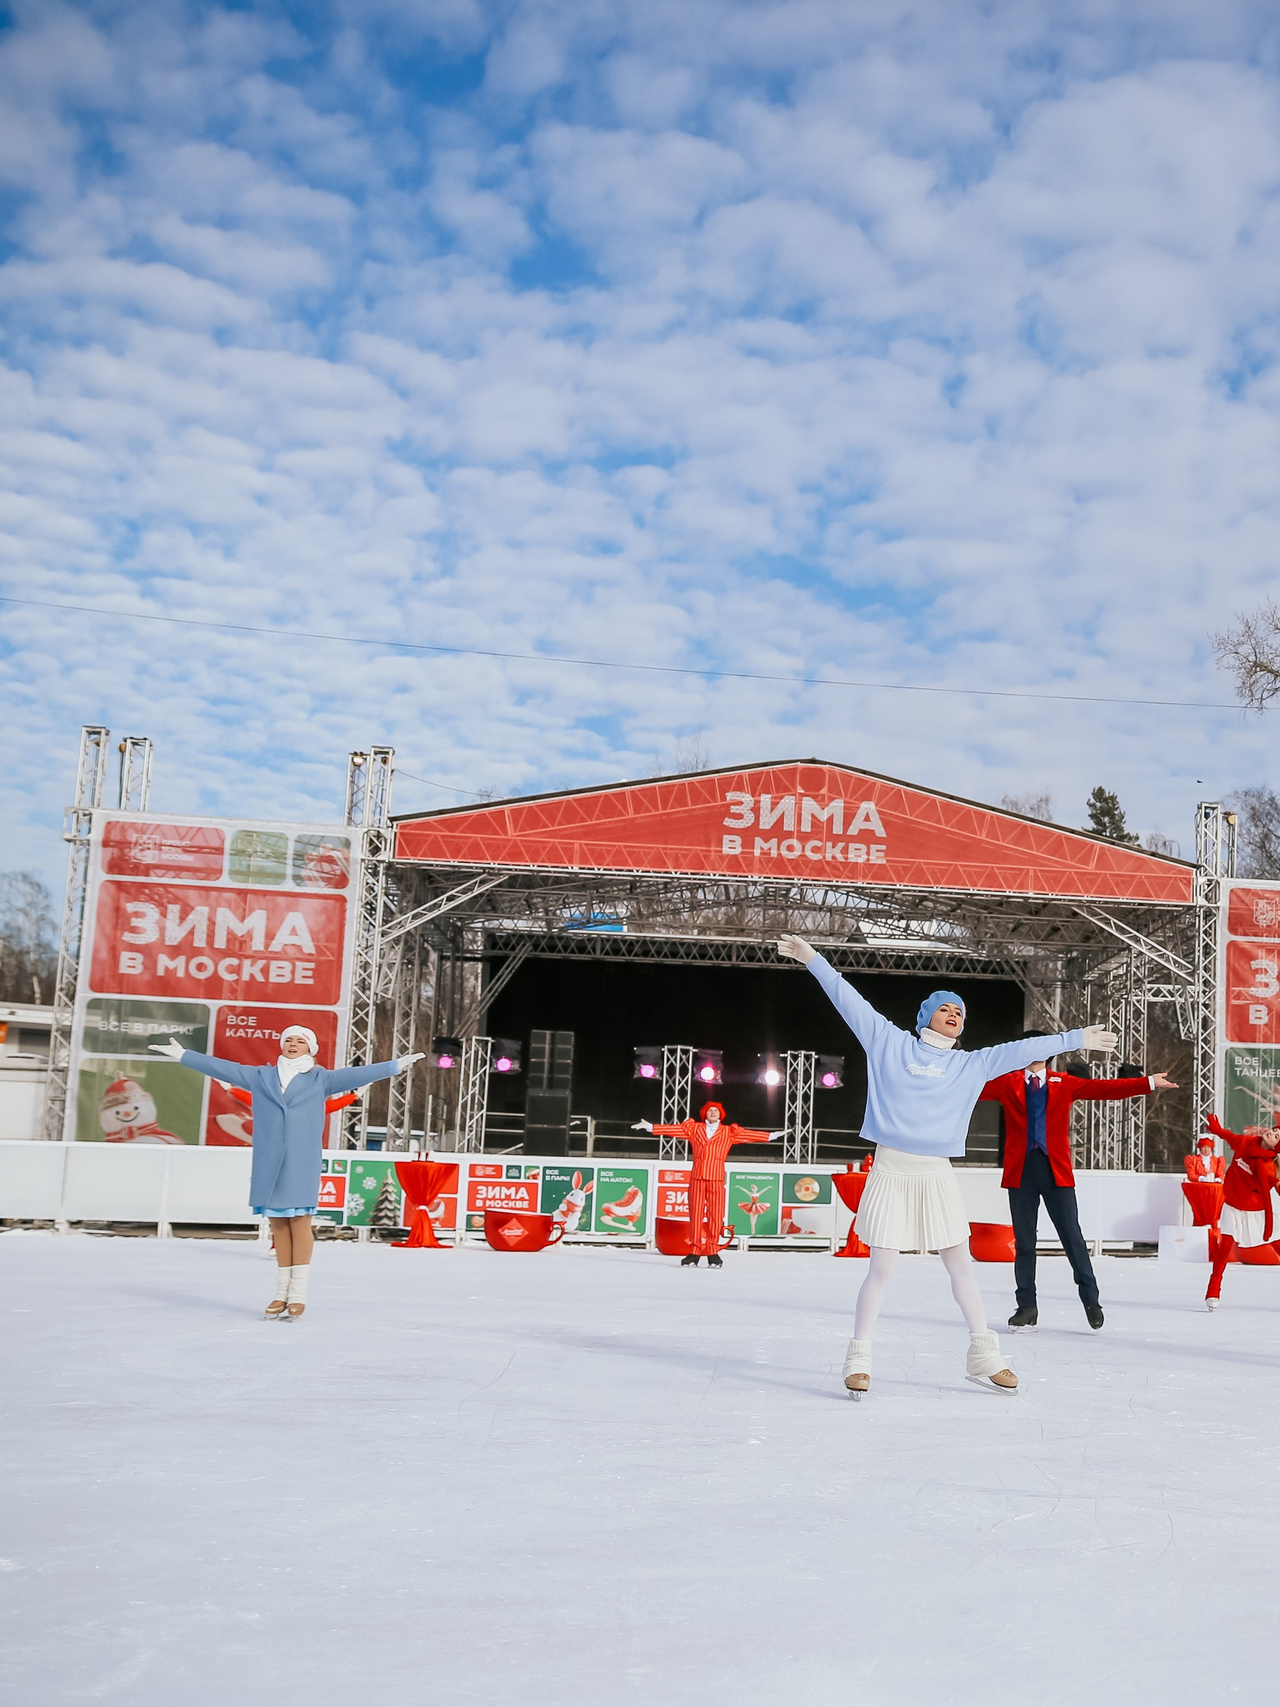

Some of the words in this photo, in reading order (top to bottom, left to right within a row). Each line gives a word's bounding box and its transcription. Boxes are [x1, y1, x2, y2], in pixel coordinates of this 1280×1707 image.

[722, 791, 887, 838] ЗИМА
[722, 834, 743, 855] В
[753, 836, 887, 864] МОСКВЕ
[121, 901, 316, 954] ЗИМА
[118, 951, 144, 975] В
[156, 953, 316, 985] МОСКВЕ
[227, 1015, 257, 1026] ВСЕ
[1249, 1005, 1269, 1025] В
[99, 1021, 129, 1032] ВСЕ
[132, 1022, 143, 1033] В
[147, 1023, 194, 1035] ПАРК!
[225, 1028, 280, 1040] КАТАТЬ
[1234, 1056, 1259, 1067] ВСЕ
[476, 1185, 529, 1200] ЗИМА
[665, 1191, 689, 1204] ЗИ
[475, 1200, 484, 1208] В
[485, 1200, 530, 1209] МОСКВЕ
[665, 1204, 673, 1213] В
